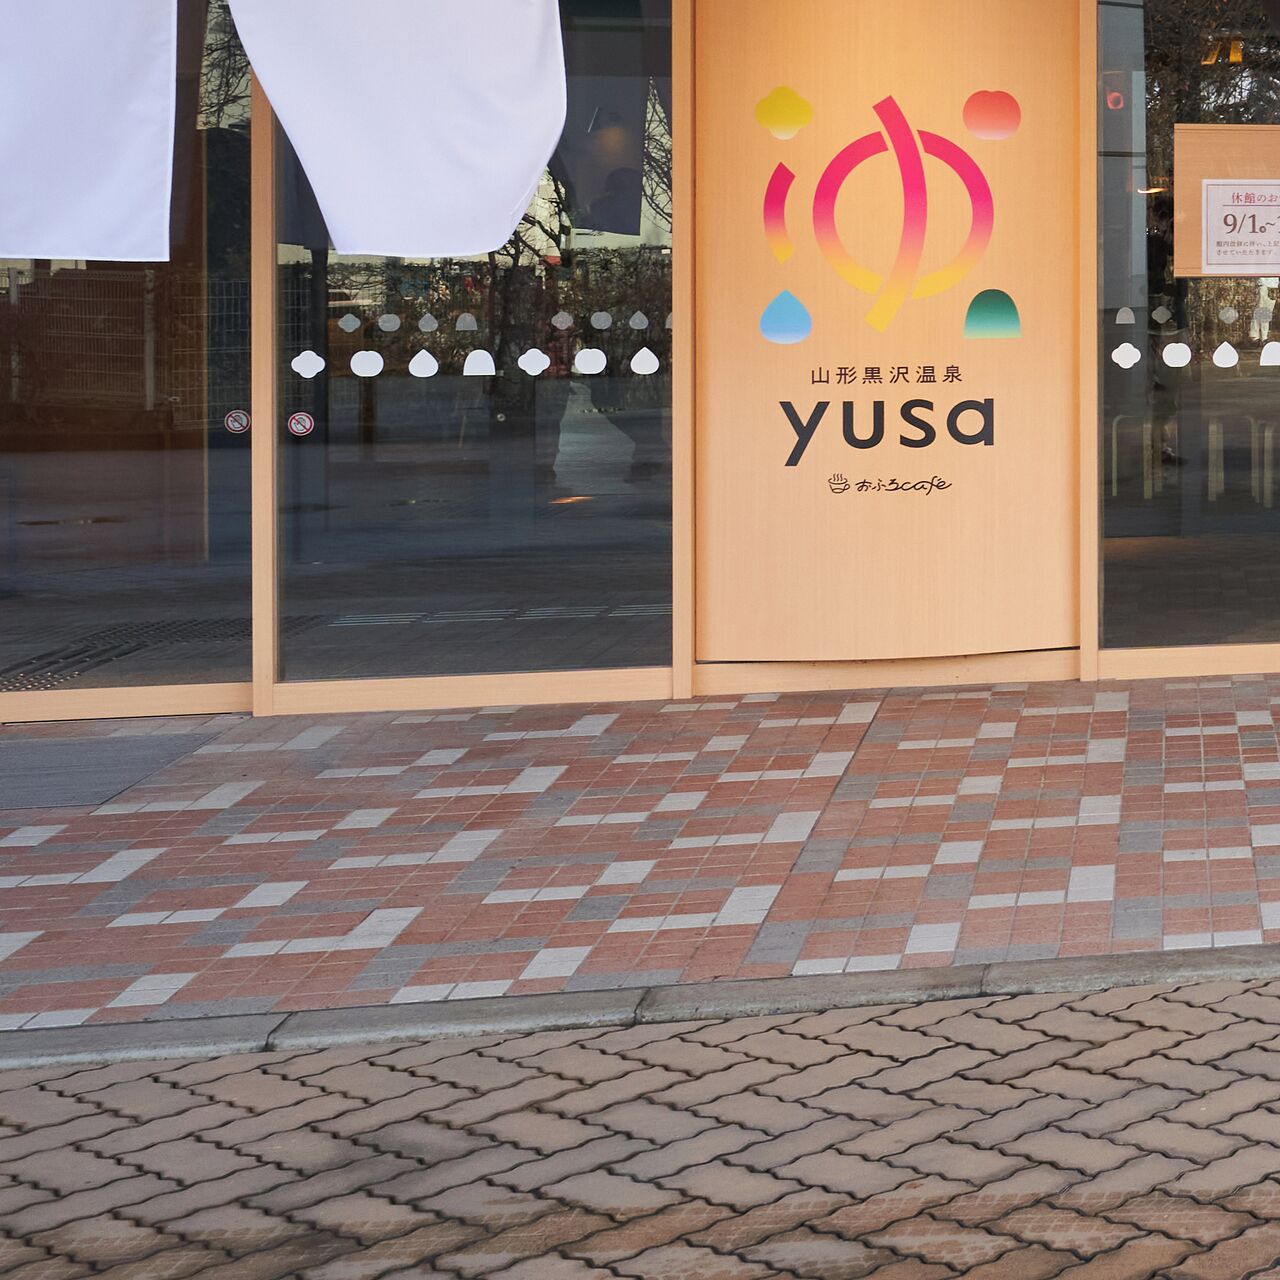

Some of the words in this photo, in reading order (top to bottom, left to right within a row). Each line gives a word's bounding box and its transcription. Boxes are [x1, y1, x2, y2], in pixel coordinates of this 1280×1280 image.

[810, 365, 963, 385] 山形黒沢温泉
[779, 398, 995, 467] yusa
